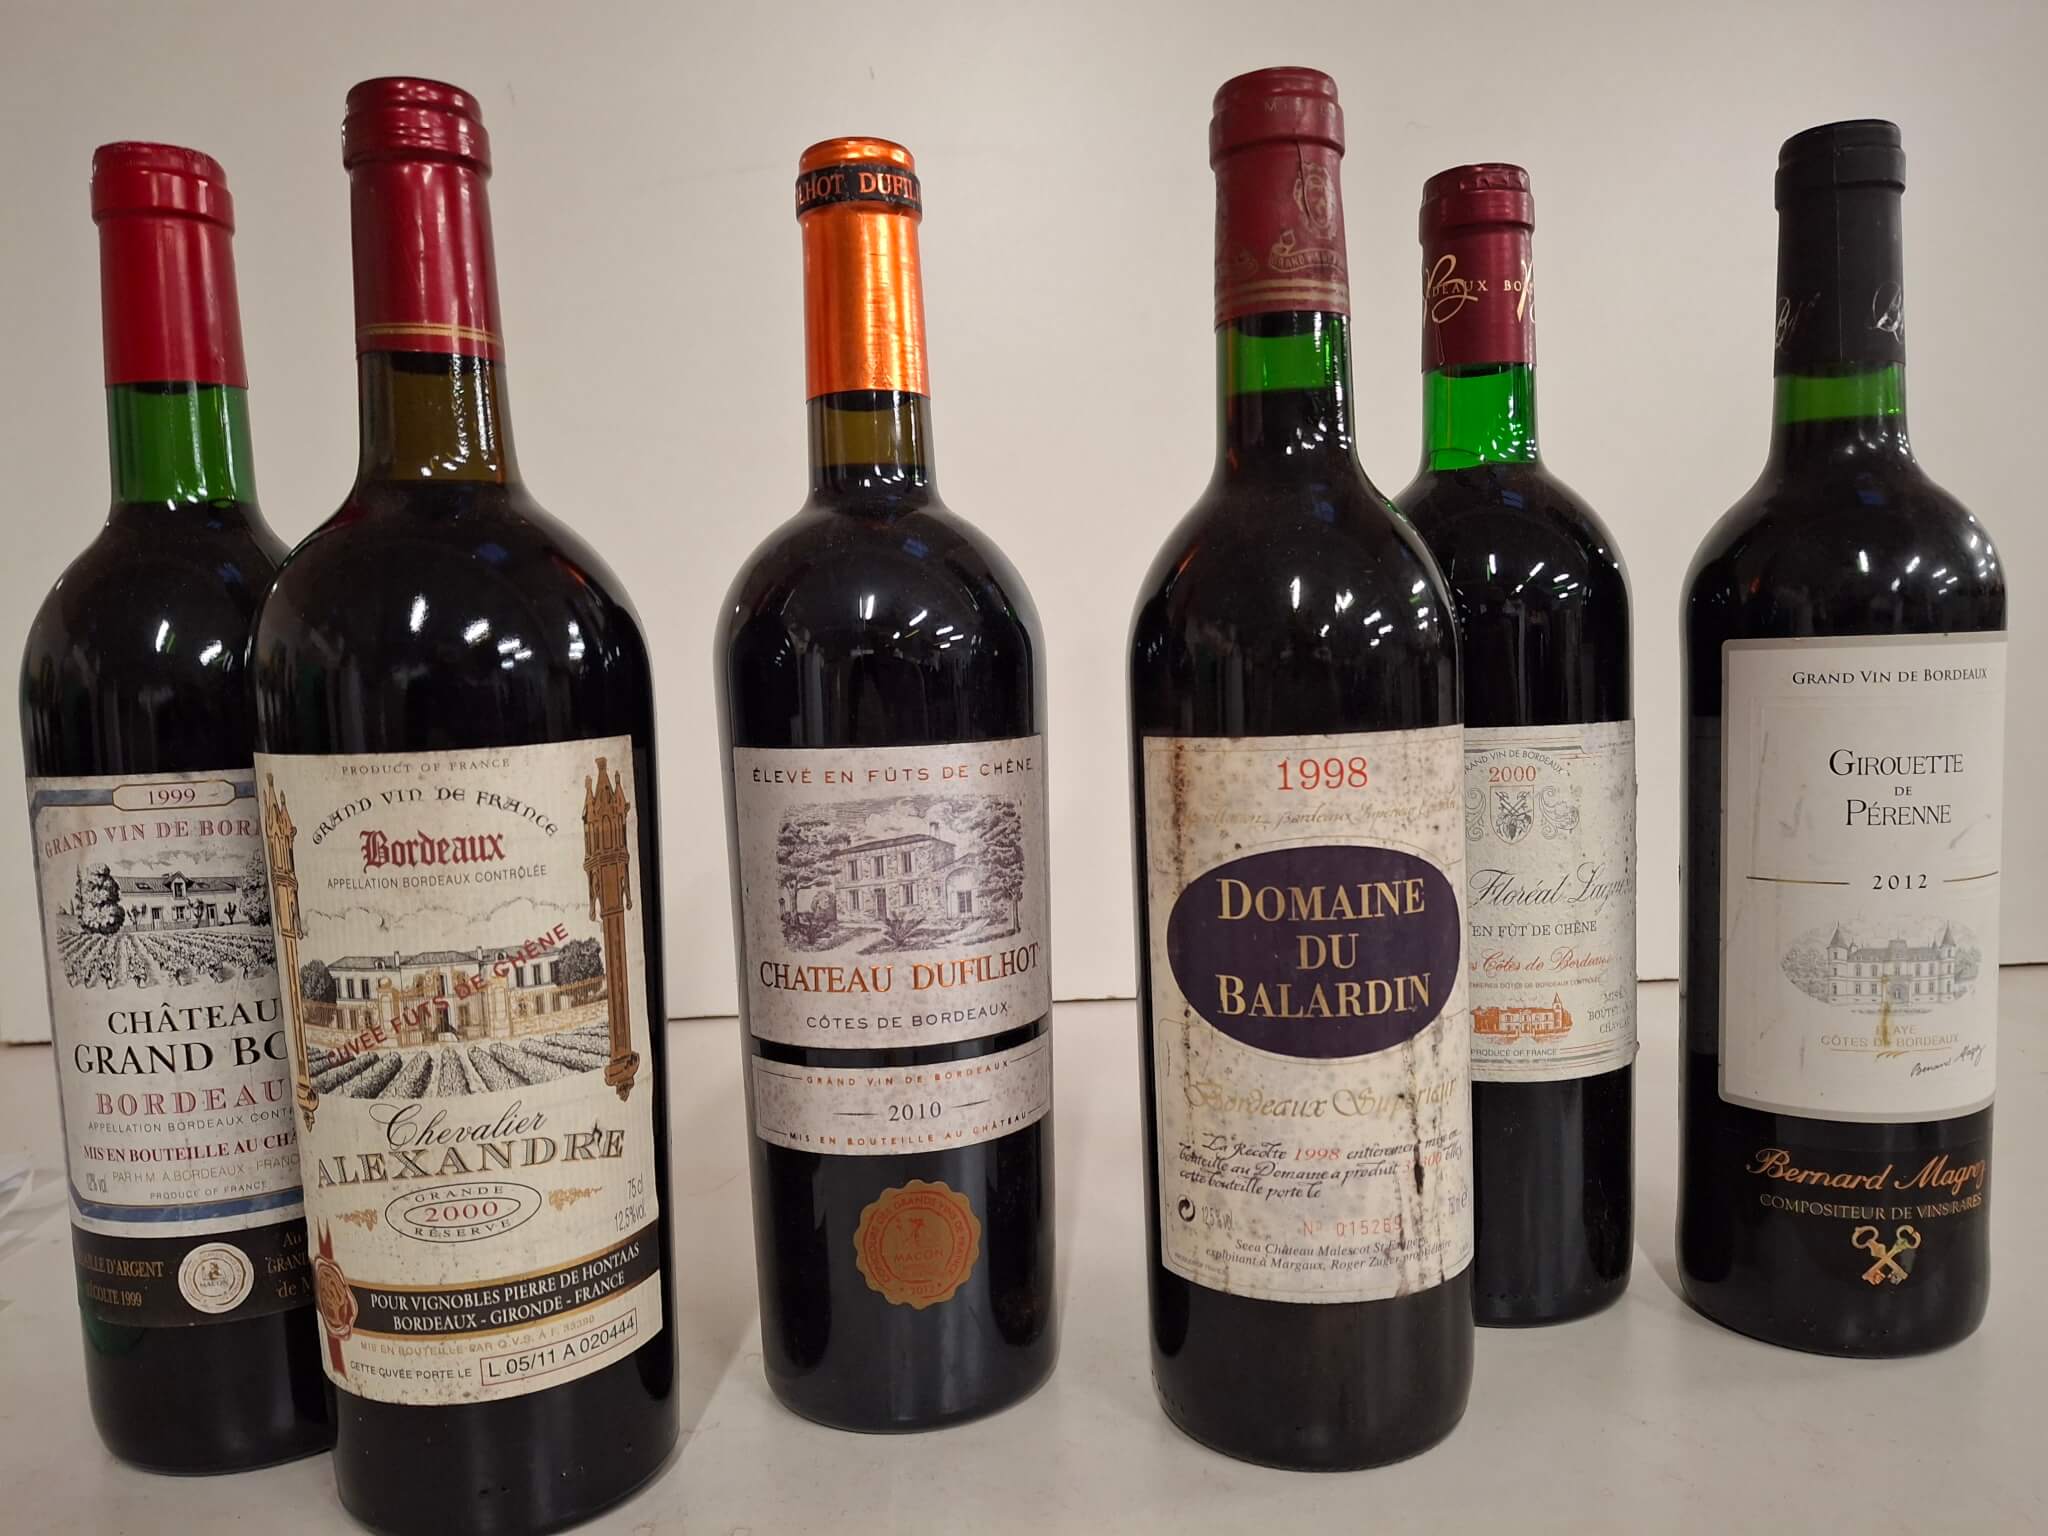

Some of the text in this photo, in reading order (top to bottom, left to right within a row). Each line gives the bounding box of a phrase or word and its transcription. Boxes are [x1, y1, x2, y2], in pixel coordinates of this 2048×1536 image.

[1792, 668, 1987, 685] GRAND VIN DE BORDEAUX
[341, 758, 511, 776] PRODUCT OF FRANCE
[752, 757, 1033, 784] ÉLEVÉ EN FÛTS DE CHÊNE
[1277, 757, 1368, 791] 1998
[1464, 750, 1563, 776] RAND VIN DE BORDEAUX
[1488, 765, 1537, 783] 2000
[1828, 749, 1964, 776] GIROUETTE
[148, 787, 196, 805] 1999
[1894, 786, 1913, 797] DE
[311, 787, 559, 846] GRAND VIN DE FRANCE
[1846, 799, 1951, 826] PÉRENNE
[45, 820, 189, 858] GRAND VIN DE
[359, 829, 507, 874] Bordeaux
[327, 864, 547, 890] APPELLATION BORDEAUX CONTRÔLÉE
[1872, 874, 1928, 890] 2012
[1216, 878, 1424, 922] DOMAINE
[1472, 925, 1494, 937] EN
[1532, 925, 1551, 936] DE
[1554, 920, 1597, 935] CHÊNE
[1296, 933, 1359, 970] DU
[760, 942, 1039, 993] CHATEAU DUFILHOT
[453, 976, 488, 1001] DE
[1216, 973, 1431, 1018] BALARDIN
[806, 1001, 1008, 1029] CÔTES DE BORDEAUX
[74, 1042, 213, 1075] GRAND
[807, 1060, 1008, 1087] GRAND VIN DE BORDEAUX
[888, 1101, 942, 1121] 2010
[88, 1115, 243, 1134] APPELLATION BORDEAUX
[369, 1100, 547, 1150] Chevalier
[788, 1131, 810, 1142] MIS
[820, 1135, 836, 1145] EN
[847, 1134, 934, 1146] BOUTEILLE
[944, 1129, 962, 1140] AU
[107, 1149, 126, 1162] EN
[130, 1143, 230, 1162] BOUTEILLE
[233, 1138, 258, 1155] AU
[318, 1127, 626, 1188] ALEXANDRE
[1296, 1147, 1341, 1161] 1998
[1746, 1148, 1894, 1190] Bernard
[204, 1187, 218, 1196] OF
[414, 1185, 505, 1203] GRANDE
[1265, 1183, 1302, 1201] porte
[424, 1201, 499, 1223] 2000
[1759, 1192, 1983, 1220] COMPOSITEUR DE VINS RARES
[1264, 1242, 1315, 1258] Château
[1330, 1258, 1367, 1273] Roger
[370, 1294, 409, 1310] POUR
[412, 1293, 501, 1312] VIGNOBLES
[504, 1279, 556, 1302] PIERRE
[559, 1272, 579, 1288] DE
[393, 1315, 476, 1331] BORDEAUX
[490, 1298, 563, 1326] GIRONDE
[574, 1270, 626, 1306] FRANCE
[350, 1360, 376, 1375] CETTE
[416, 1369, 454, 1380] PORTE
[457, 1368, 472, 1379] LE
[562, 1340, 577, 1361] A
[578, 1315, 635, 1354] 020444
